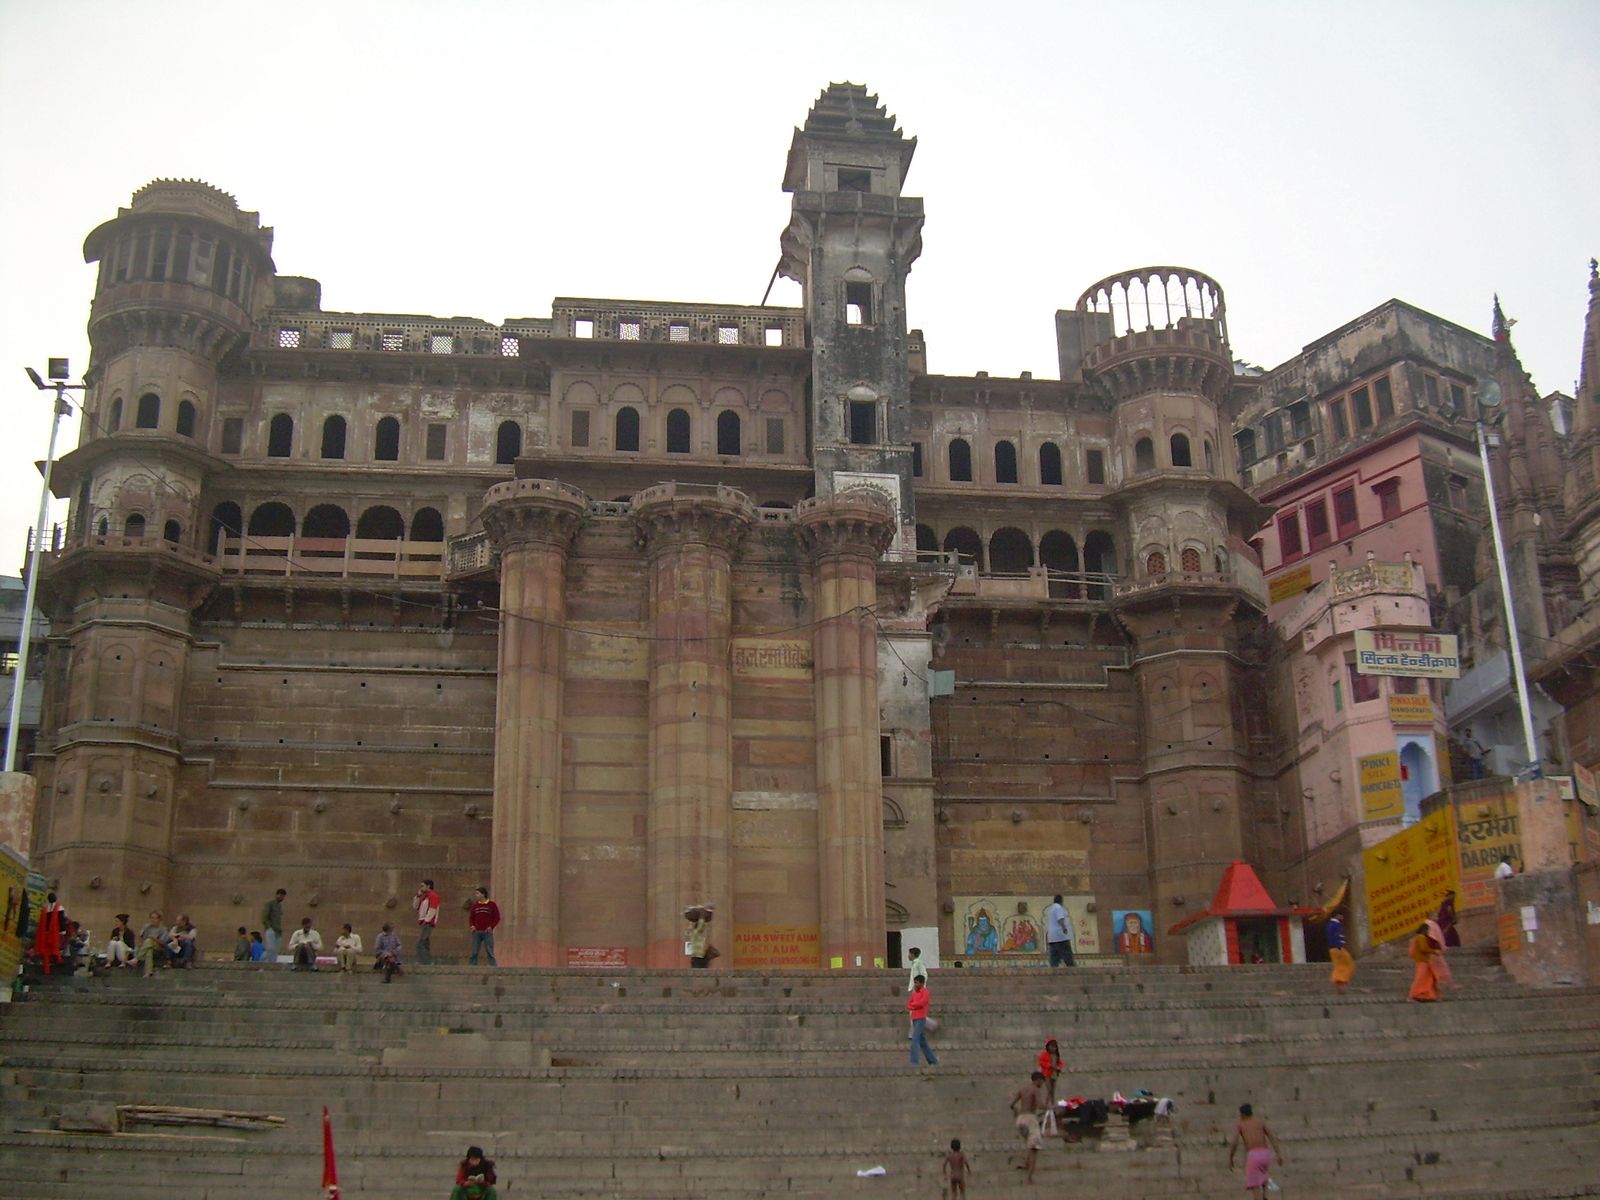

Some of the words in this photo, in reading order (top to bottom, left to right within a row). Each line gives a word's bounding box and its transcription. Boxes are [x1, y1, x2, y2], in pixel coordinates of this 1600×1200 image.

[1361, 757, 1390, 770] PINKI
[735, 933, 761, 943] AUM
[796, 933, 817, 943] AUM
[772, 944, 800, 954] AUM
